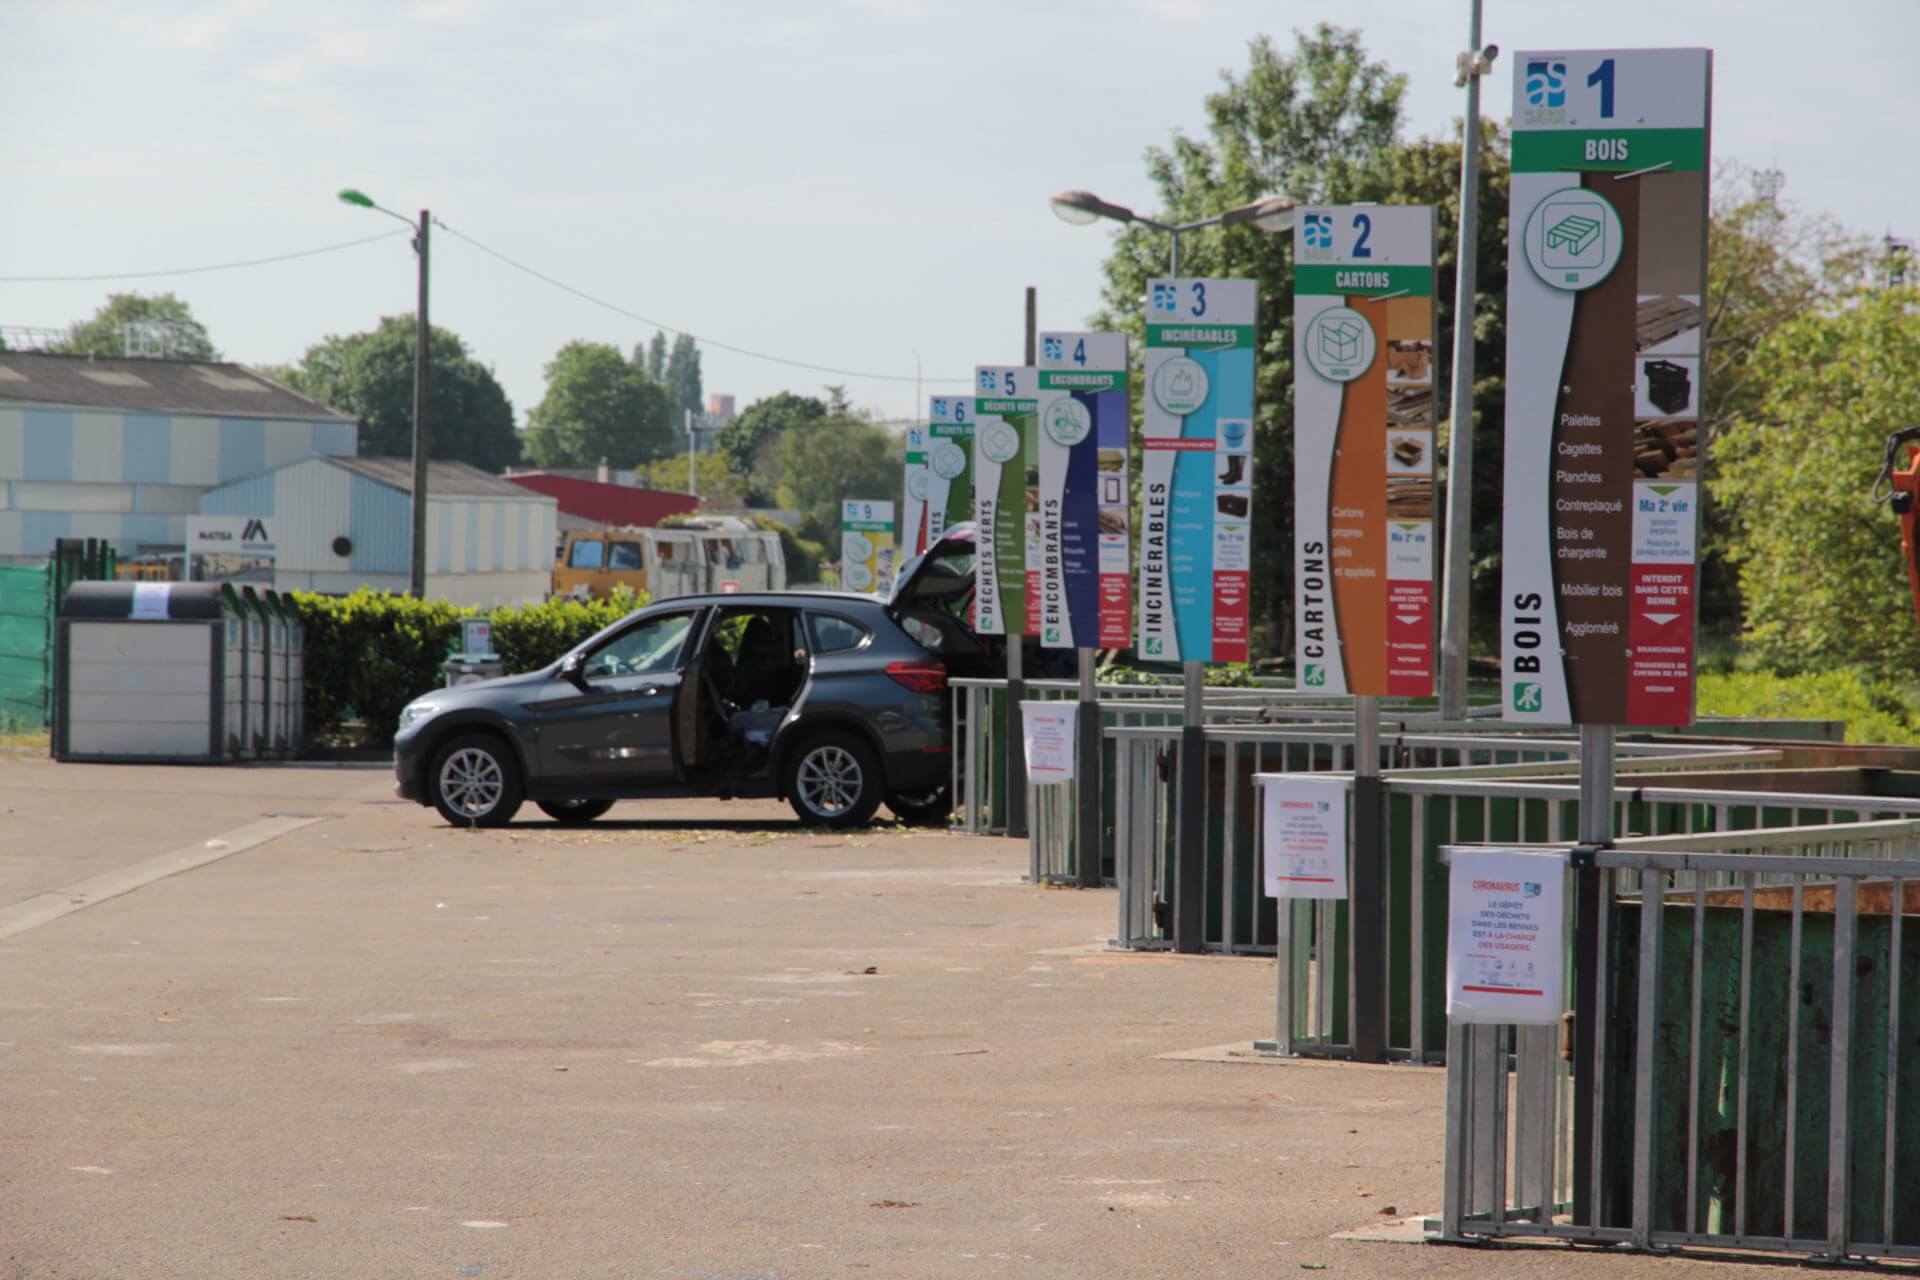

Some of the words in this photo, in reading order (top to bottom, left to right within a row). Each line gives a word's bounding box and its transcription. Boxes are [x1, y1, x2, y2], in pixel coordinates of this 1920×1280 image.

[1587, 58, 1615, 119] 1
[1585, 139, 1629, 161] BOIS
[1352, 213, 1372, 258] 2
[1335, 271, 1390, 288] CARTONS
[1191, 282, 1206, 317] 3
[1073, 337, 1087, 367] 4
[1004, 371, 1017, 396] 5
[955, 401, 965, 422] 6
[1561, 414, 1601, 427] Palettes
[1558, 442, 1603, 457] Cagettes
[1556, 470, 1602, 483] Planches
[1556, 499, 1623, 514] Contreplaqué
[1639, 499, 1656, 512] Ma
[1672, 499, 1689, 512] vie
[981, 500, 993, 544] VERTS
[1557, 527, 1578, 540] Bois
[1581, 527, 1594, 540] de
[1143, 483, 1165, 632] INCINÉRABLES
[1558, 547, 1608, 561] charpente
[1045, 499, 1060, 625] ENCOMBRANTS
[1642, 575, 1683, 584] INTERDIT
[1561, 583, 1601, 597] Mobilier
[1602, 584, 1624, 597] bois
[1635, 586, 1658, 594] DANS
[1660, 586, 1689, 594] CETTE
[1304, 541, 1324, 658] CARTONS
[1646, 597, 1677, 606] BENNE
[1514, 592, 1541, 674] BOIS
[1565, 621, 1620, 636] Aggloméré
[1473, 880, 1521, 892] CORONAVIRUS
[1488, 901, 1497, 909] LE
[1480, 911, 1495, 919] DES
[1472, 920, 1493, 929] DANS
[1494, 921, 1507, 930] LES
[1508, 922, 1539, 932] BENNES
[1472, 930, 1487, 938] EST
[1494, 932, 1504, 940] LA
[1505, 932, 1537, 942] CHARGE
[1478, 941, 1494, 949] DES
